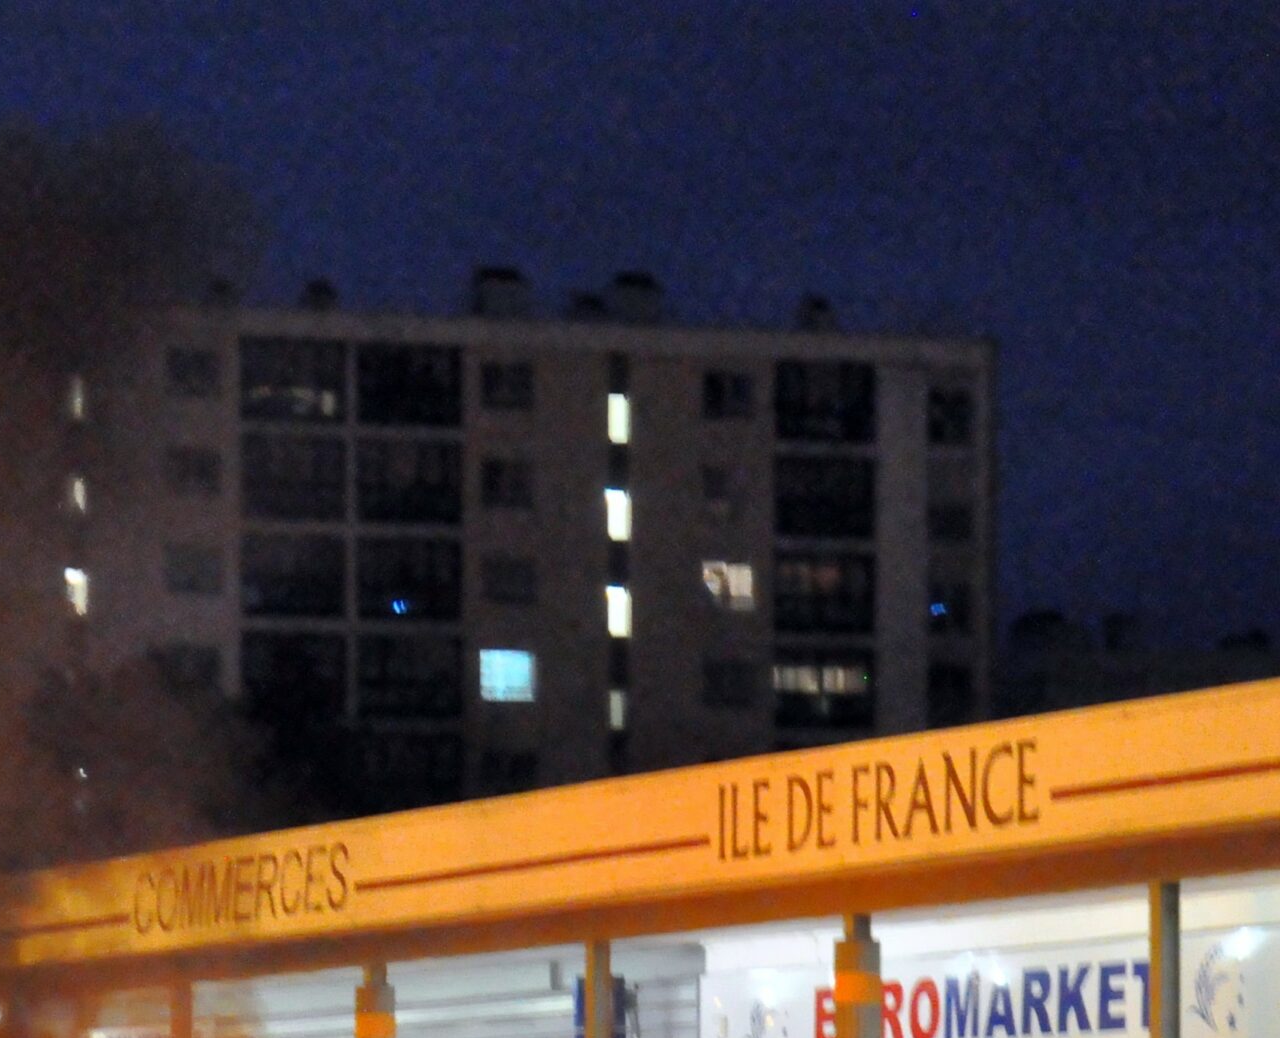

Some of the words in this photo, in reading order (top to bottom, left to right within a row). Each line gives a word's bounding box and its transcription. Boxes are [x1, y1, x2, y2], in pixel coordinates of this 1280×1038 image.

[718, 777, 773, 862] ILE
[786, 769, 836, 853] DE
[851, 737, 1039, 846] FRANCE
[134, 842, 349, 935] COMMERCES
